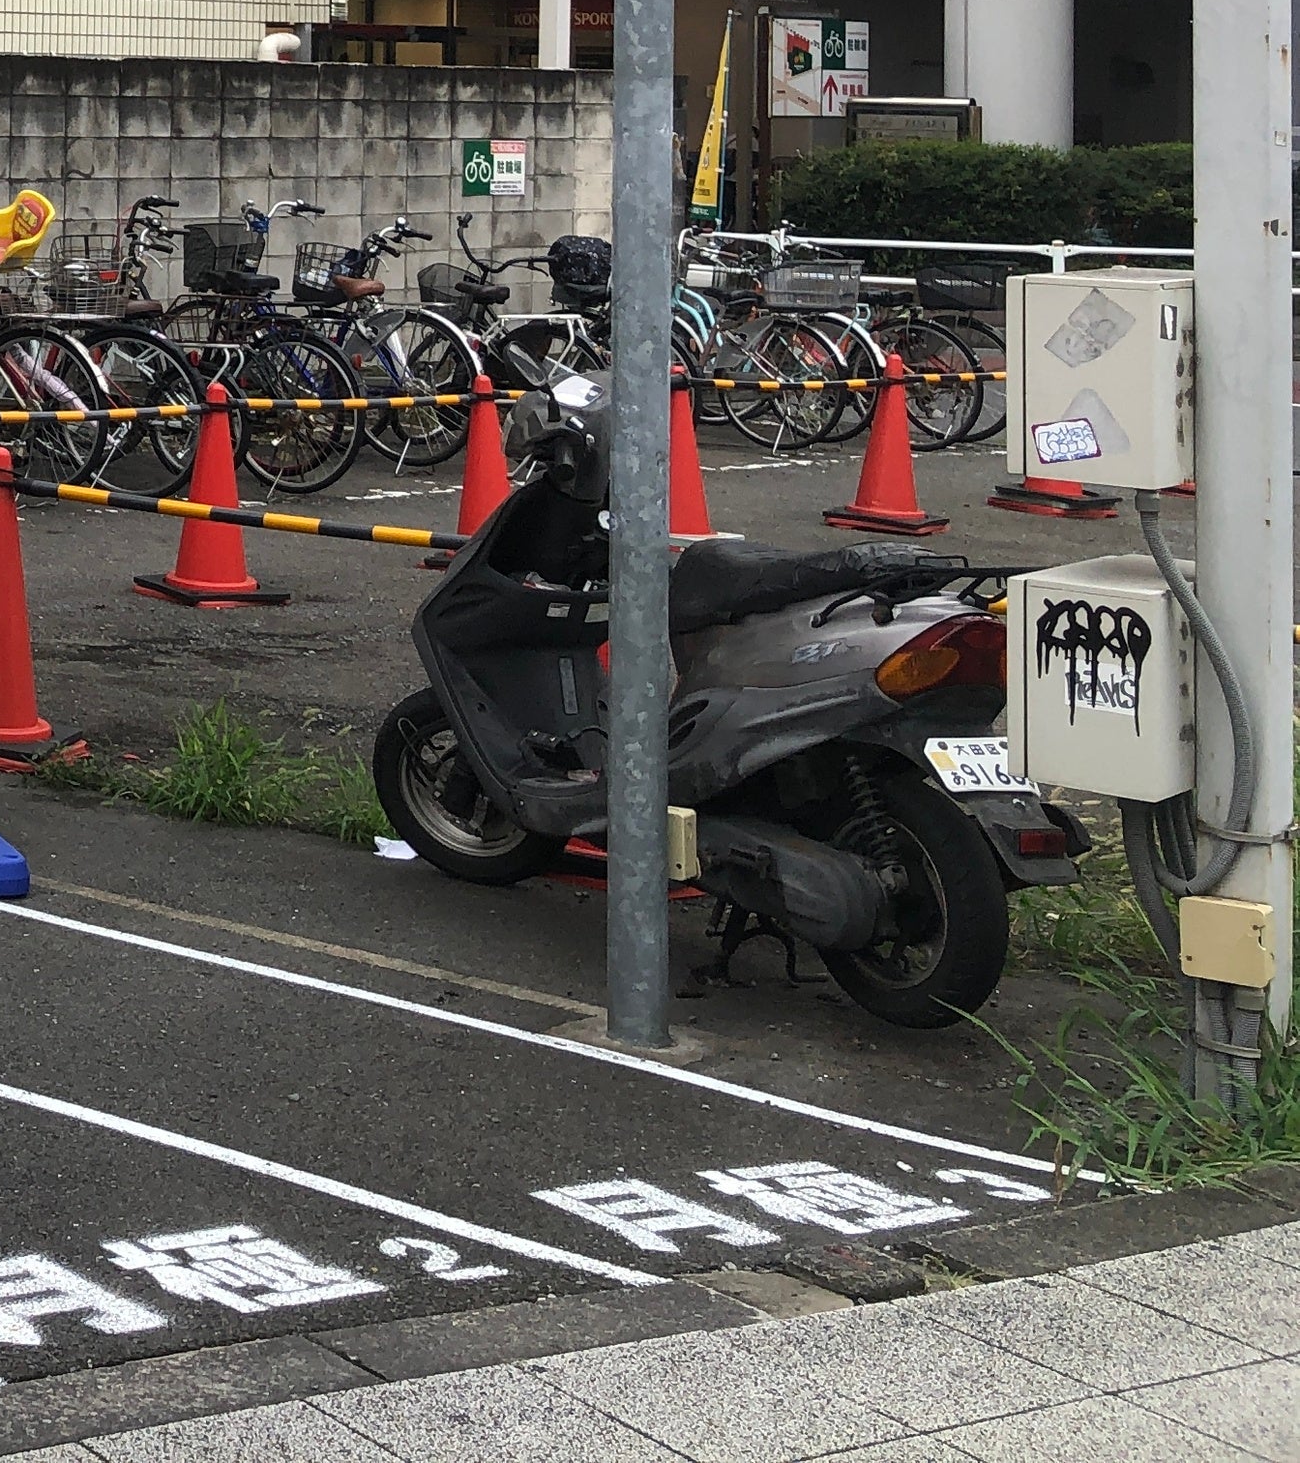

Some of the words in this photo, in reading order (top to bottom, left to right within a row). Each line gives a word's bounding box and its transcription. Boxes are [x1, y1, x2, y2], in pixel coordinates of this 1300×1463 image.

[953, 744, 1001, 755] 大田区
[528, 1159, 972, 1253] 月極
[935, 1166, 1054, 1200] 3
[378, 1235, 508, 1281] 2
